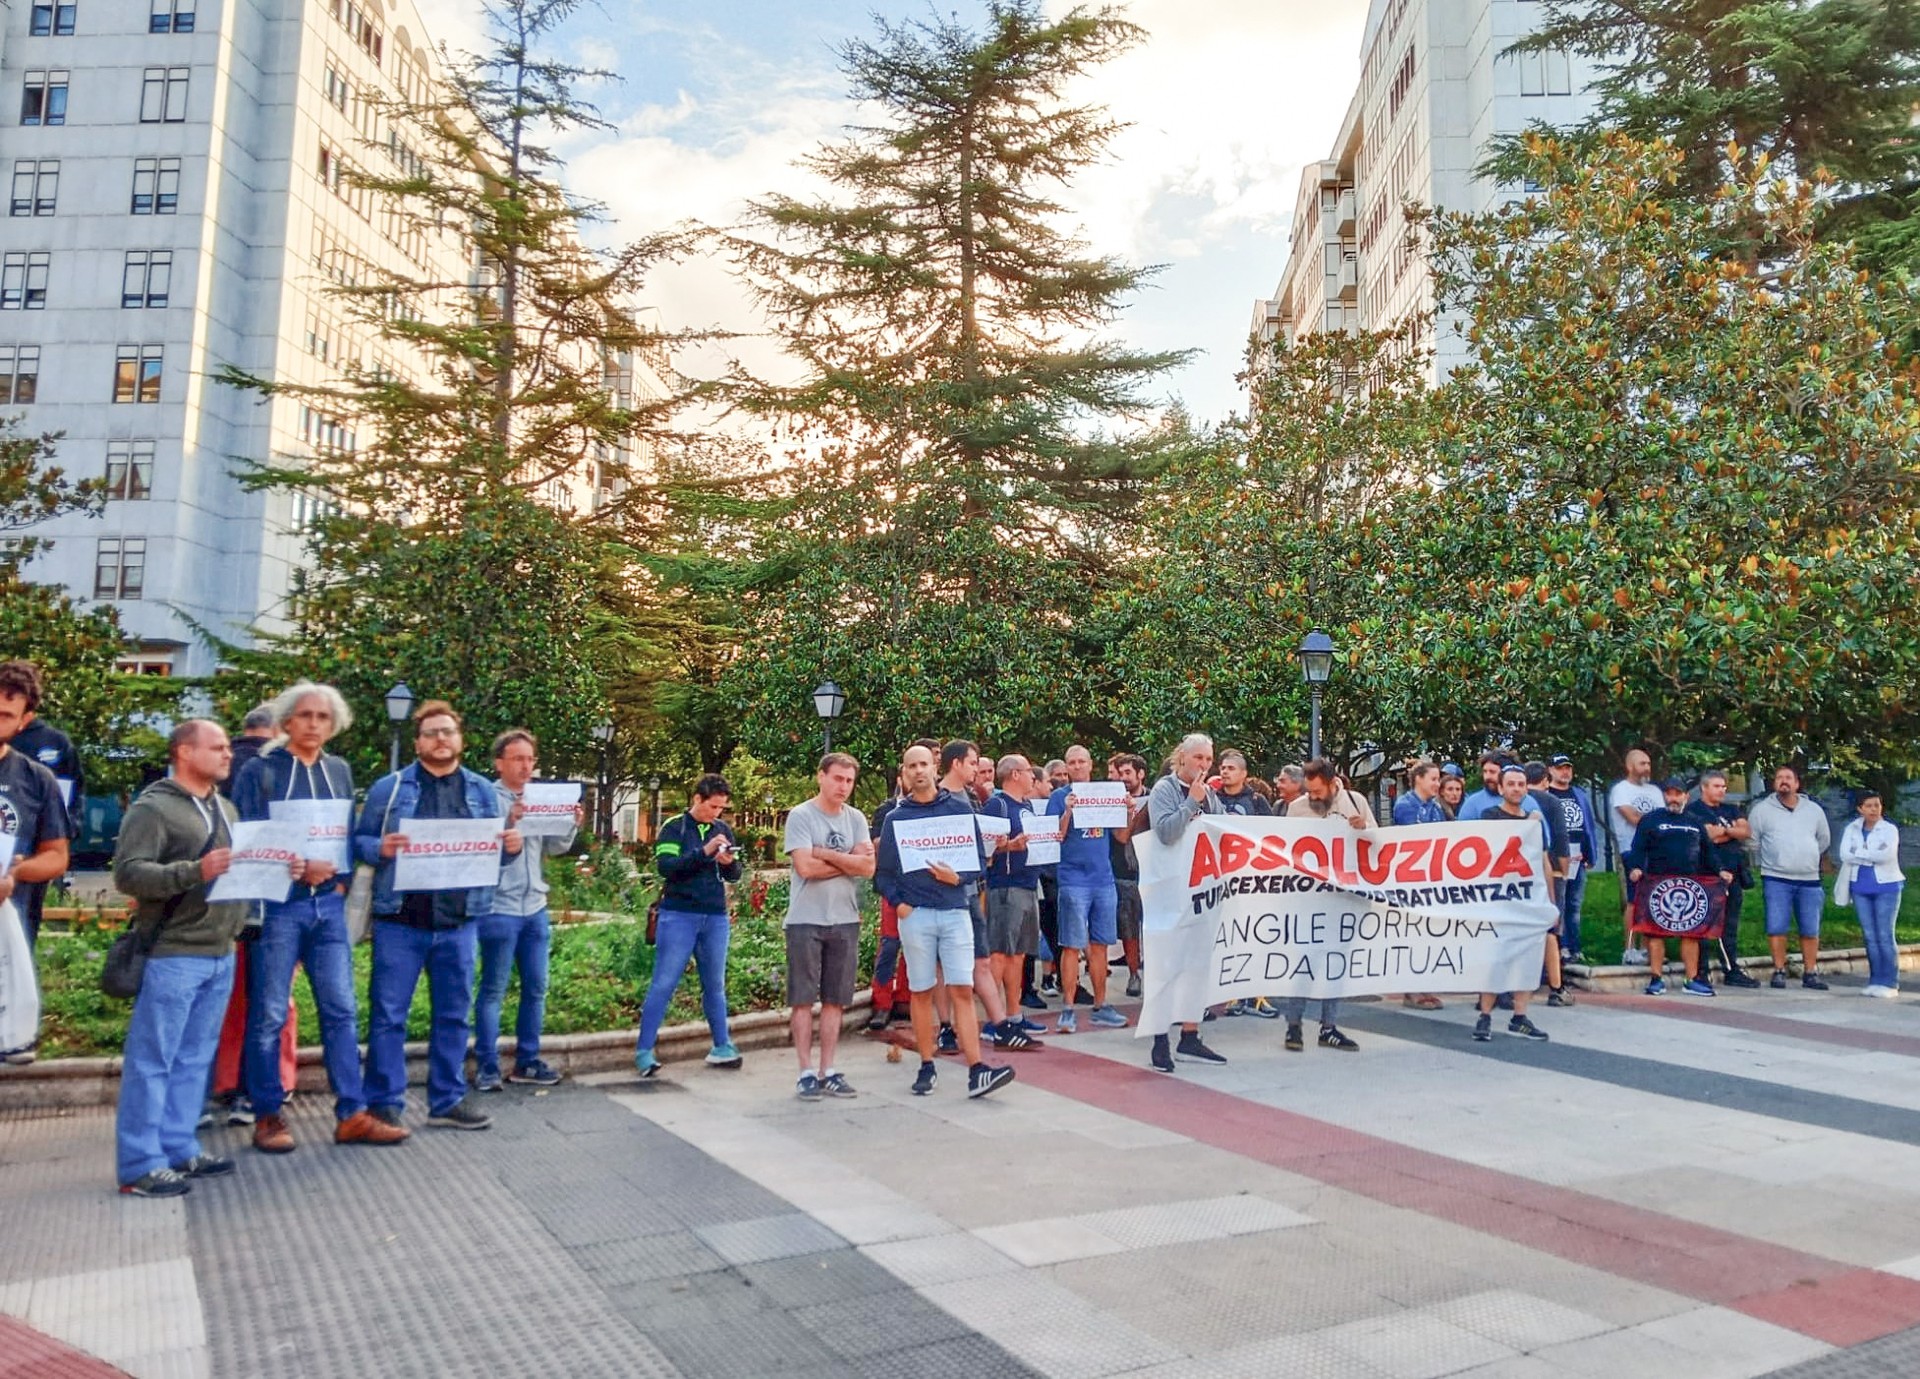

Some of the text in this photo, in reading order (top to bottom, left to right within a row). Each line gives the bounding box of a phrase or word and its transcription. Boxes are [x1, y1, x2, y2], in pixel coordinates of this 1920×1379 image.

[1073, 797, 1127, 805] ABSOLUZIOA
[403, 841, 499, 854] ABSOLUZIOA
[901, 835, 974, 847] ABSOLUZIOA
[1189, 832, 1534, 888] ABSOLUZIOA
[1191, 875, 1315, 914] TUACEXEKO
[1655, 879, 1704, 897] TUBACEX
[1339, 910, 1499, 943] BORRUKA
[1219, 945, 1463, 986] EZ DA DELITUA!
